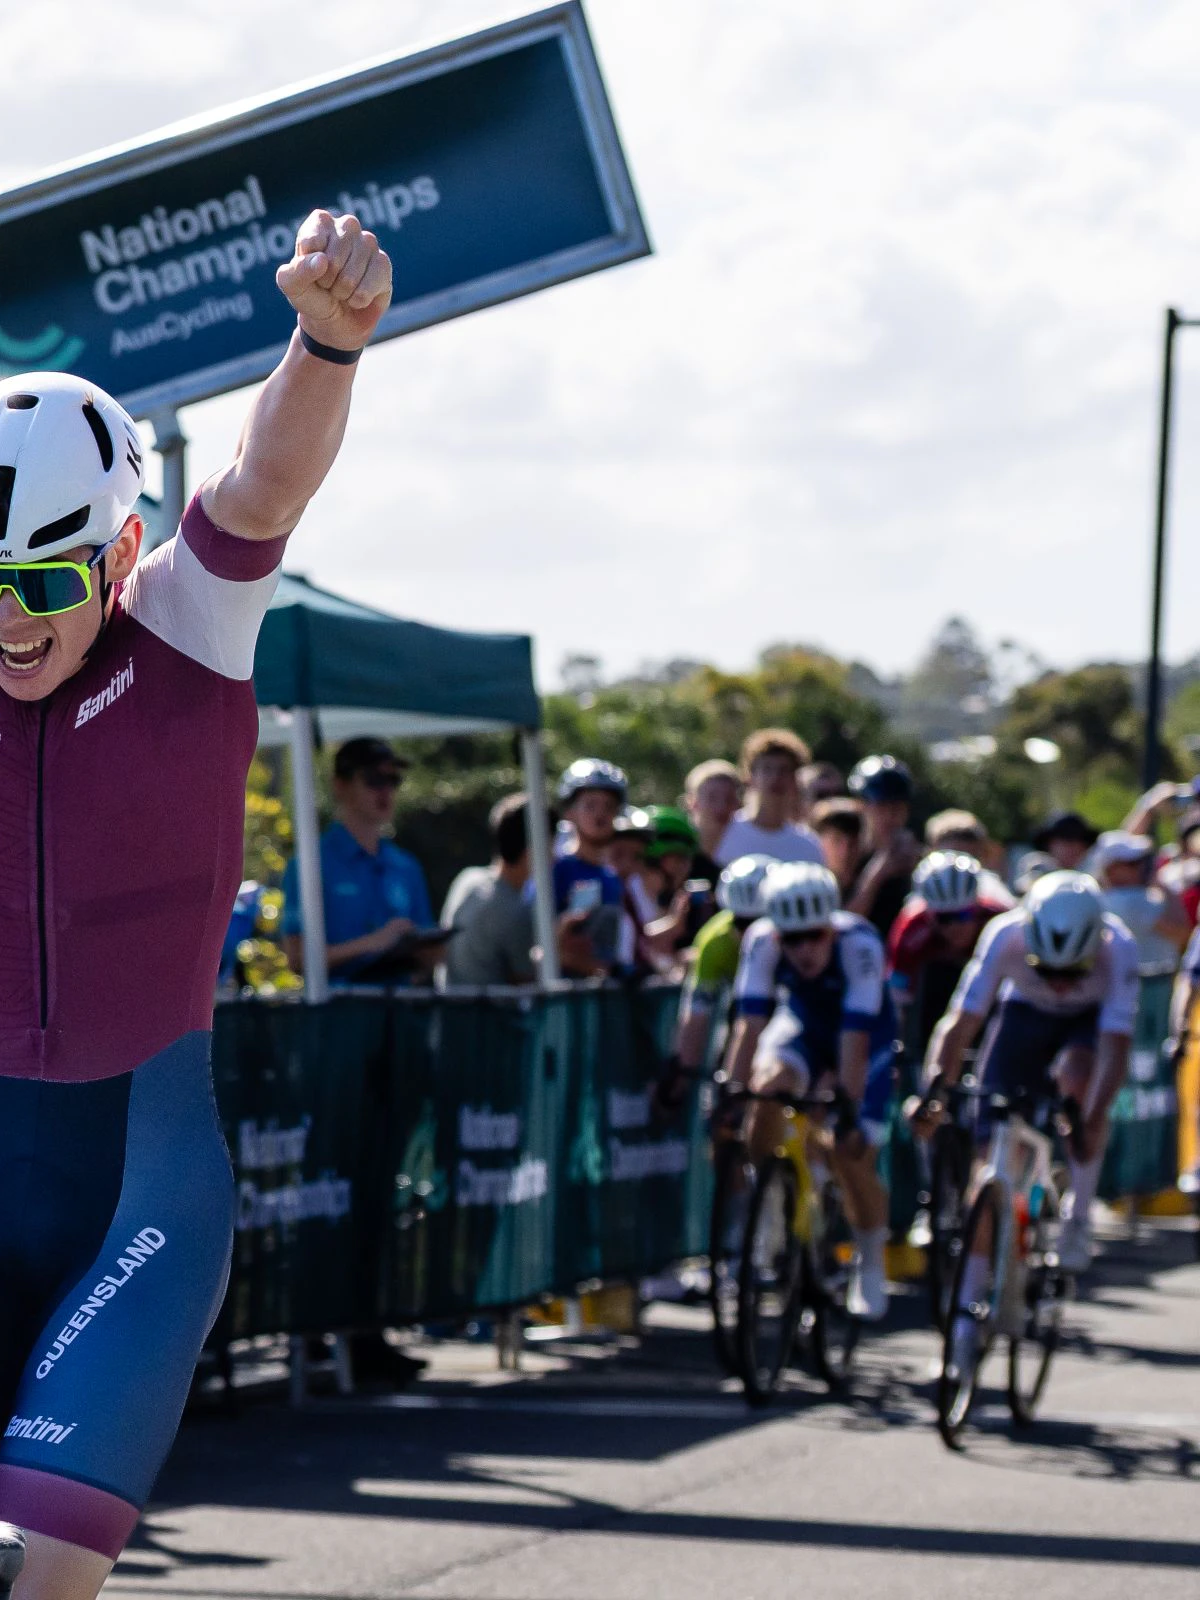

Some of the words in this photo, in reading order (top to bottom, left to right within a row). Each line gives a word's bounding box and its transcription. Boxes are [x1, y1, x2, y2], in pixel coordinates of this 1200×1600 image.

[79, 174, 267, 273] National
[94, 176, 440, 314] Champiohips
[111, 292, 254, 357] AusCycling
[74, 657, 134, 729] Santini
[35, 1227, 166, 1380] QUEENSLAND
